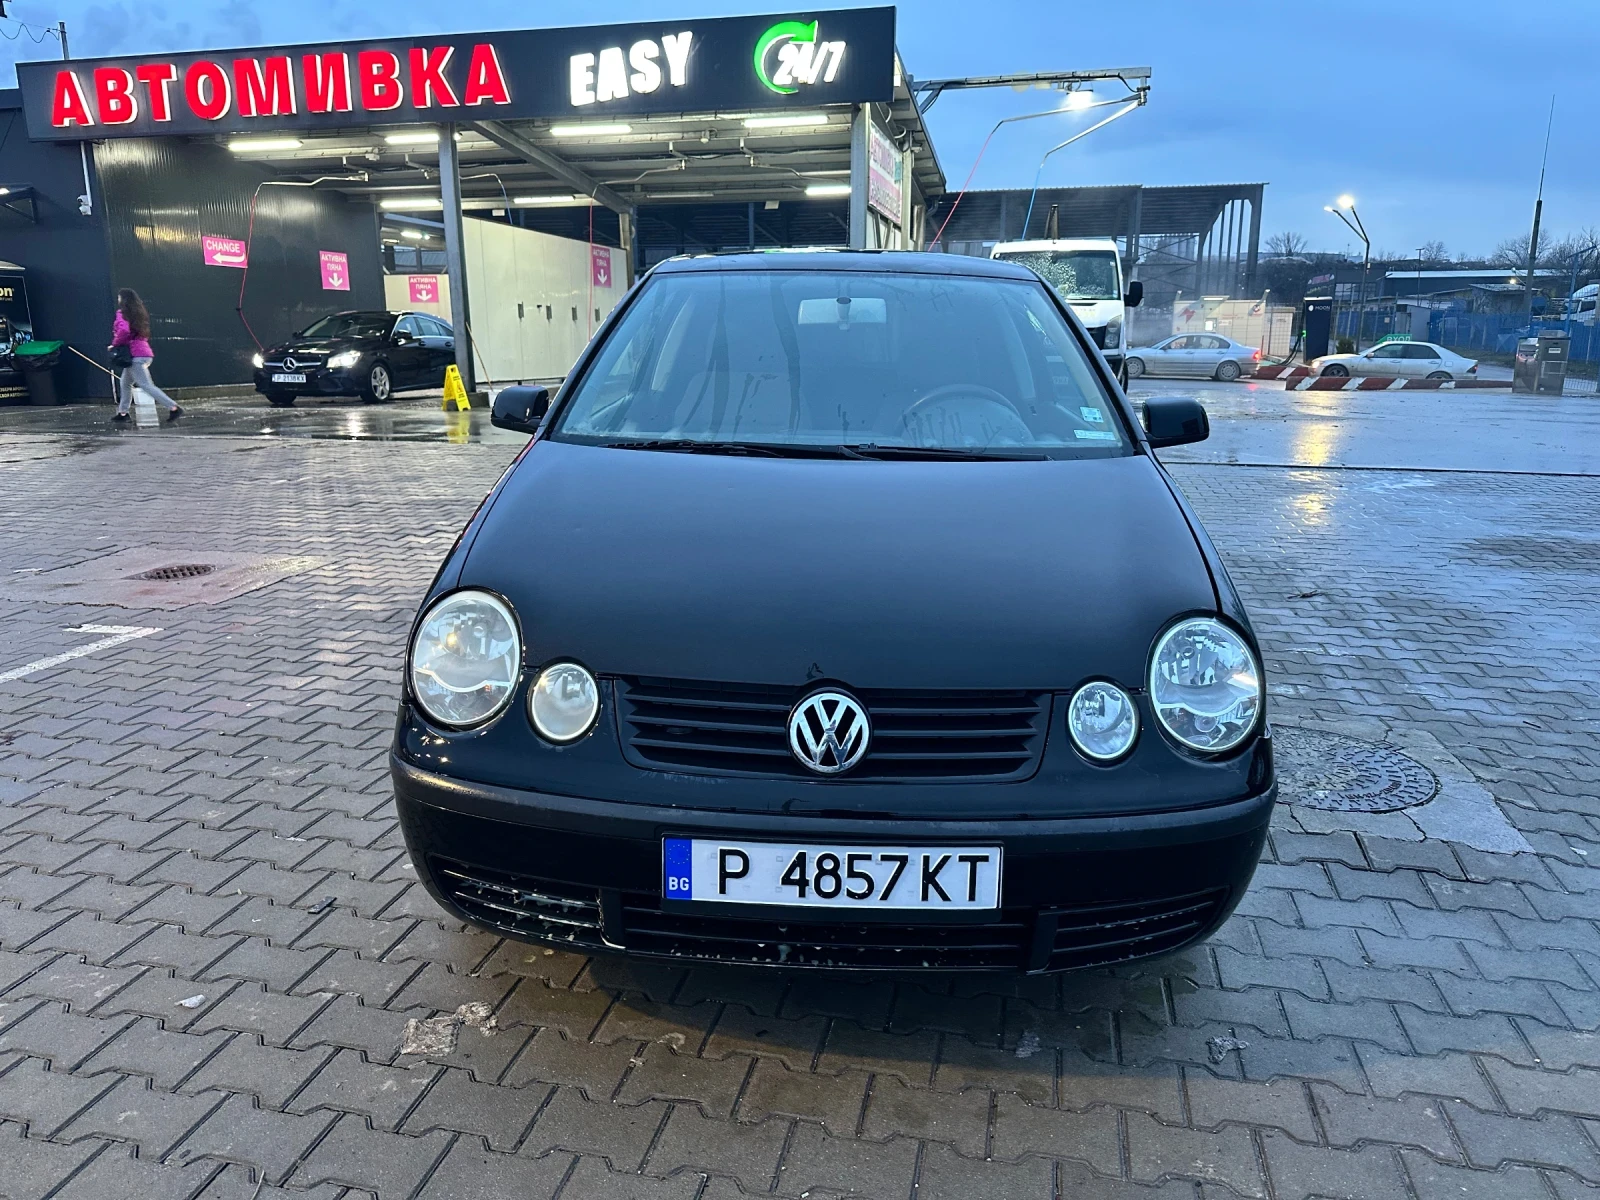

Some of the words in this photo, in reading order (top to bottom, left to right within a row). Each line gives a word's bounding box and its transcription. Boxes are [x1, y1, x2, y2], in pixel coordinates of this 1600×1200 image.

[570, 31, 694, 107] EASY
[51, 43, 511, 127] АВТОМИВКА
[206, 240, 240, 253] CHANGE
[321, 253, 347, 263] АКТИВНА
[668, 876, 690, 891] BG
[718, 847, 750, 895] P
